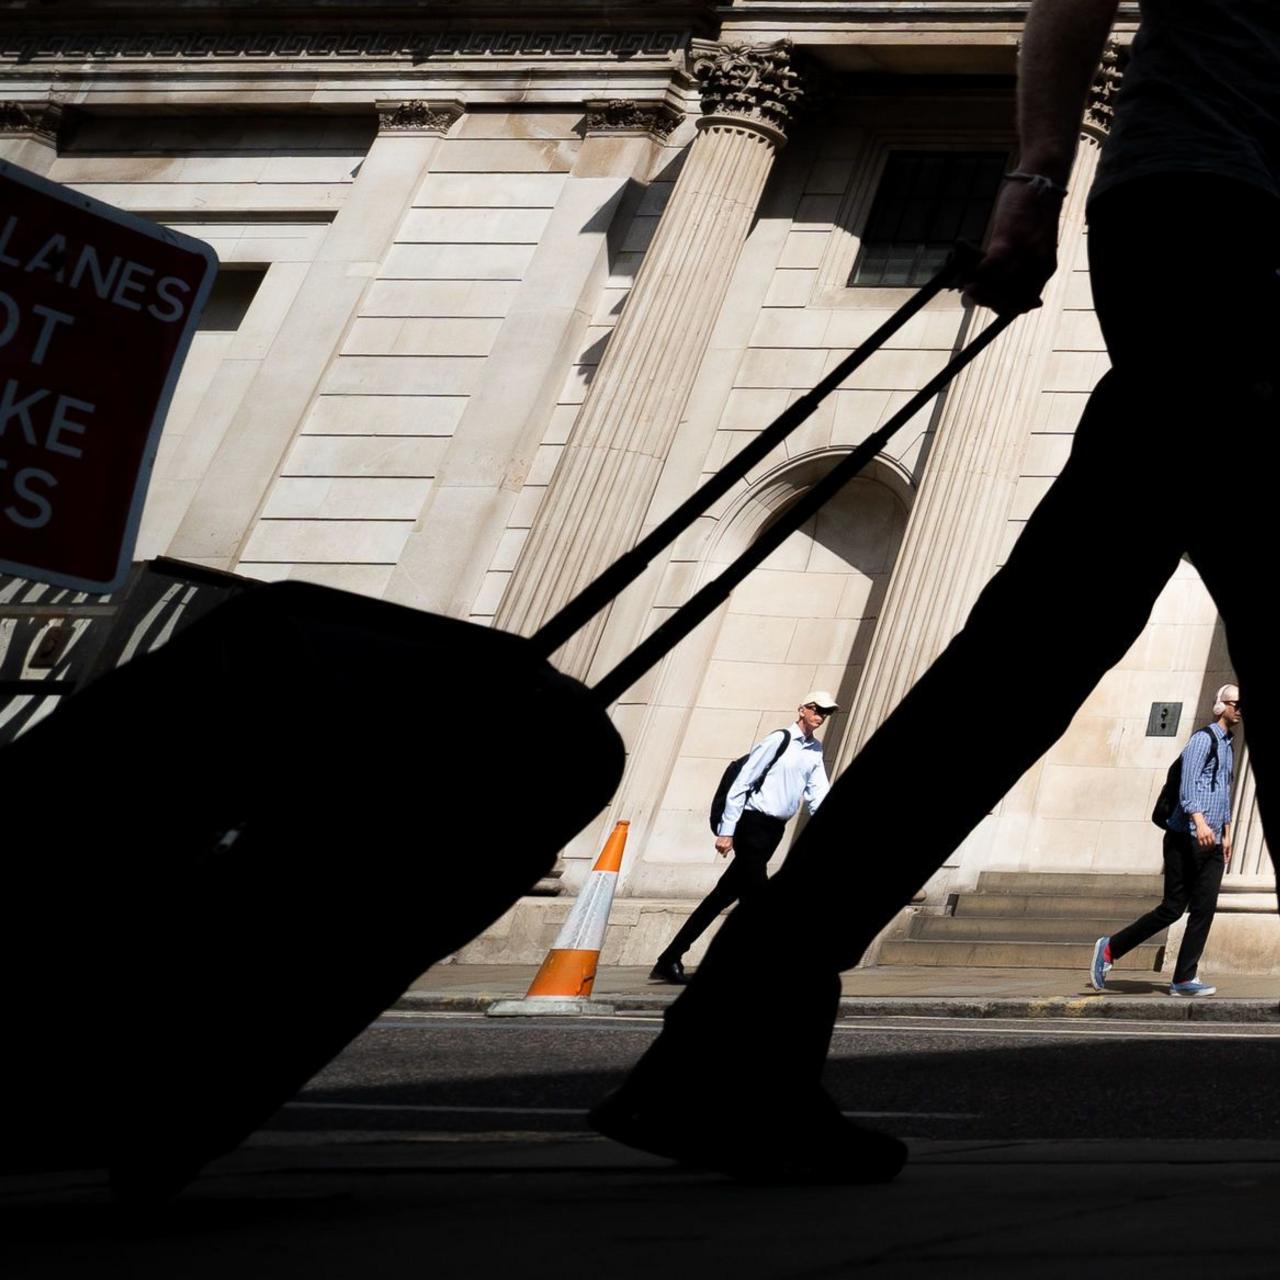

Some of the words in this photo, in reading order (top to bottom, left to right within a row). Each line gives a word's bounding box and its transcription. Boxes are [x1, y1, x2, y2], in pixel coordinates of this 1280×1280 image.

[0, 215, 191, 324] LANES
[0, 377, 96, 459] KE
[0, 457, 58, 529] S
